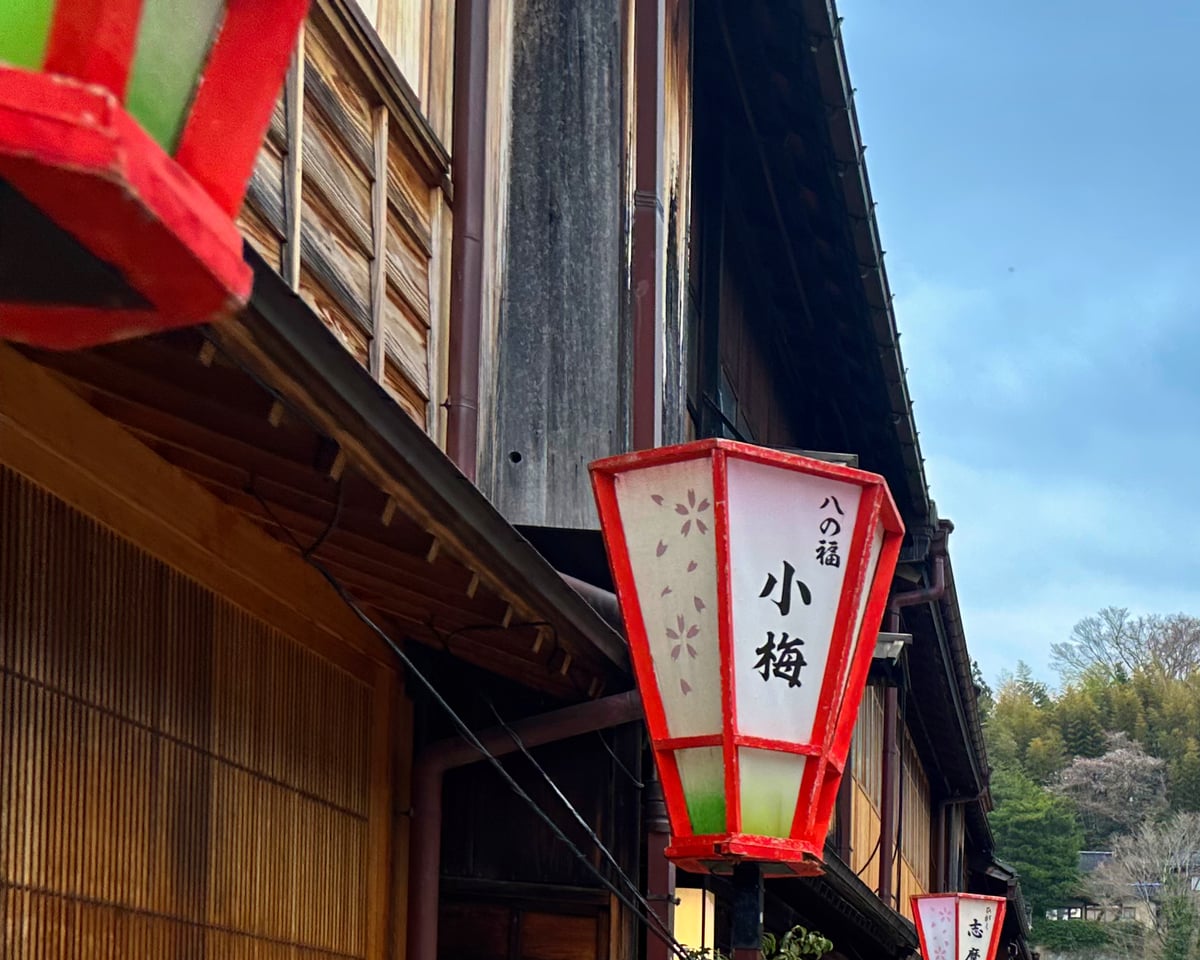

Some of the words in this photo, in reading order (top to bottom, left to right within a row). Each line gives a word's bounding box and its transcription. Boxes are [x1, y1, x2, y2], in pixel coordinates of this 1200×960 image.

[815, 494, 845, 569] 八の福
[752, 560, 812, 689] 小梅
